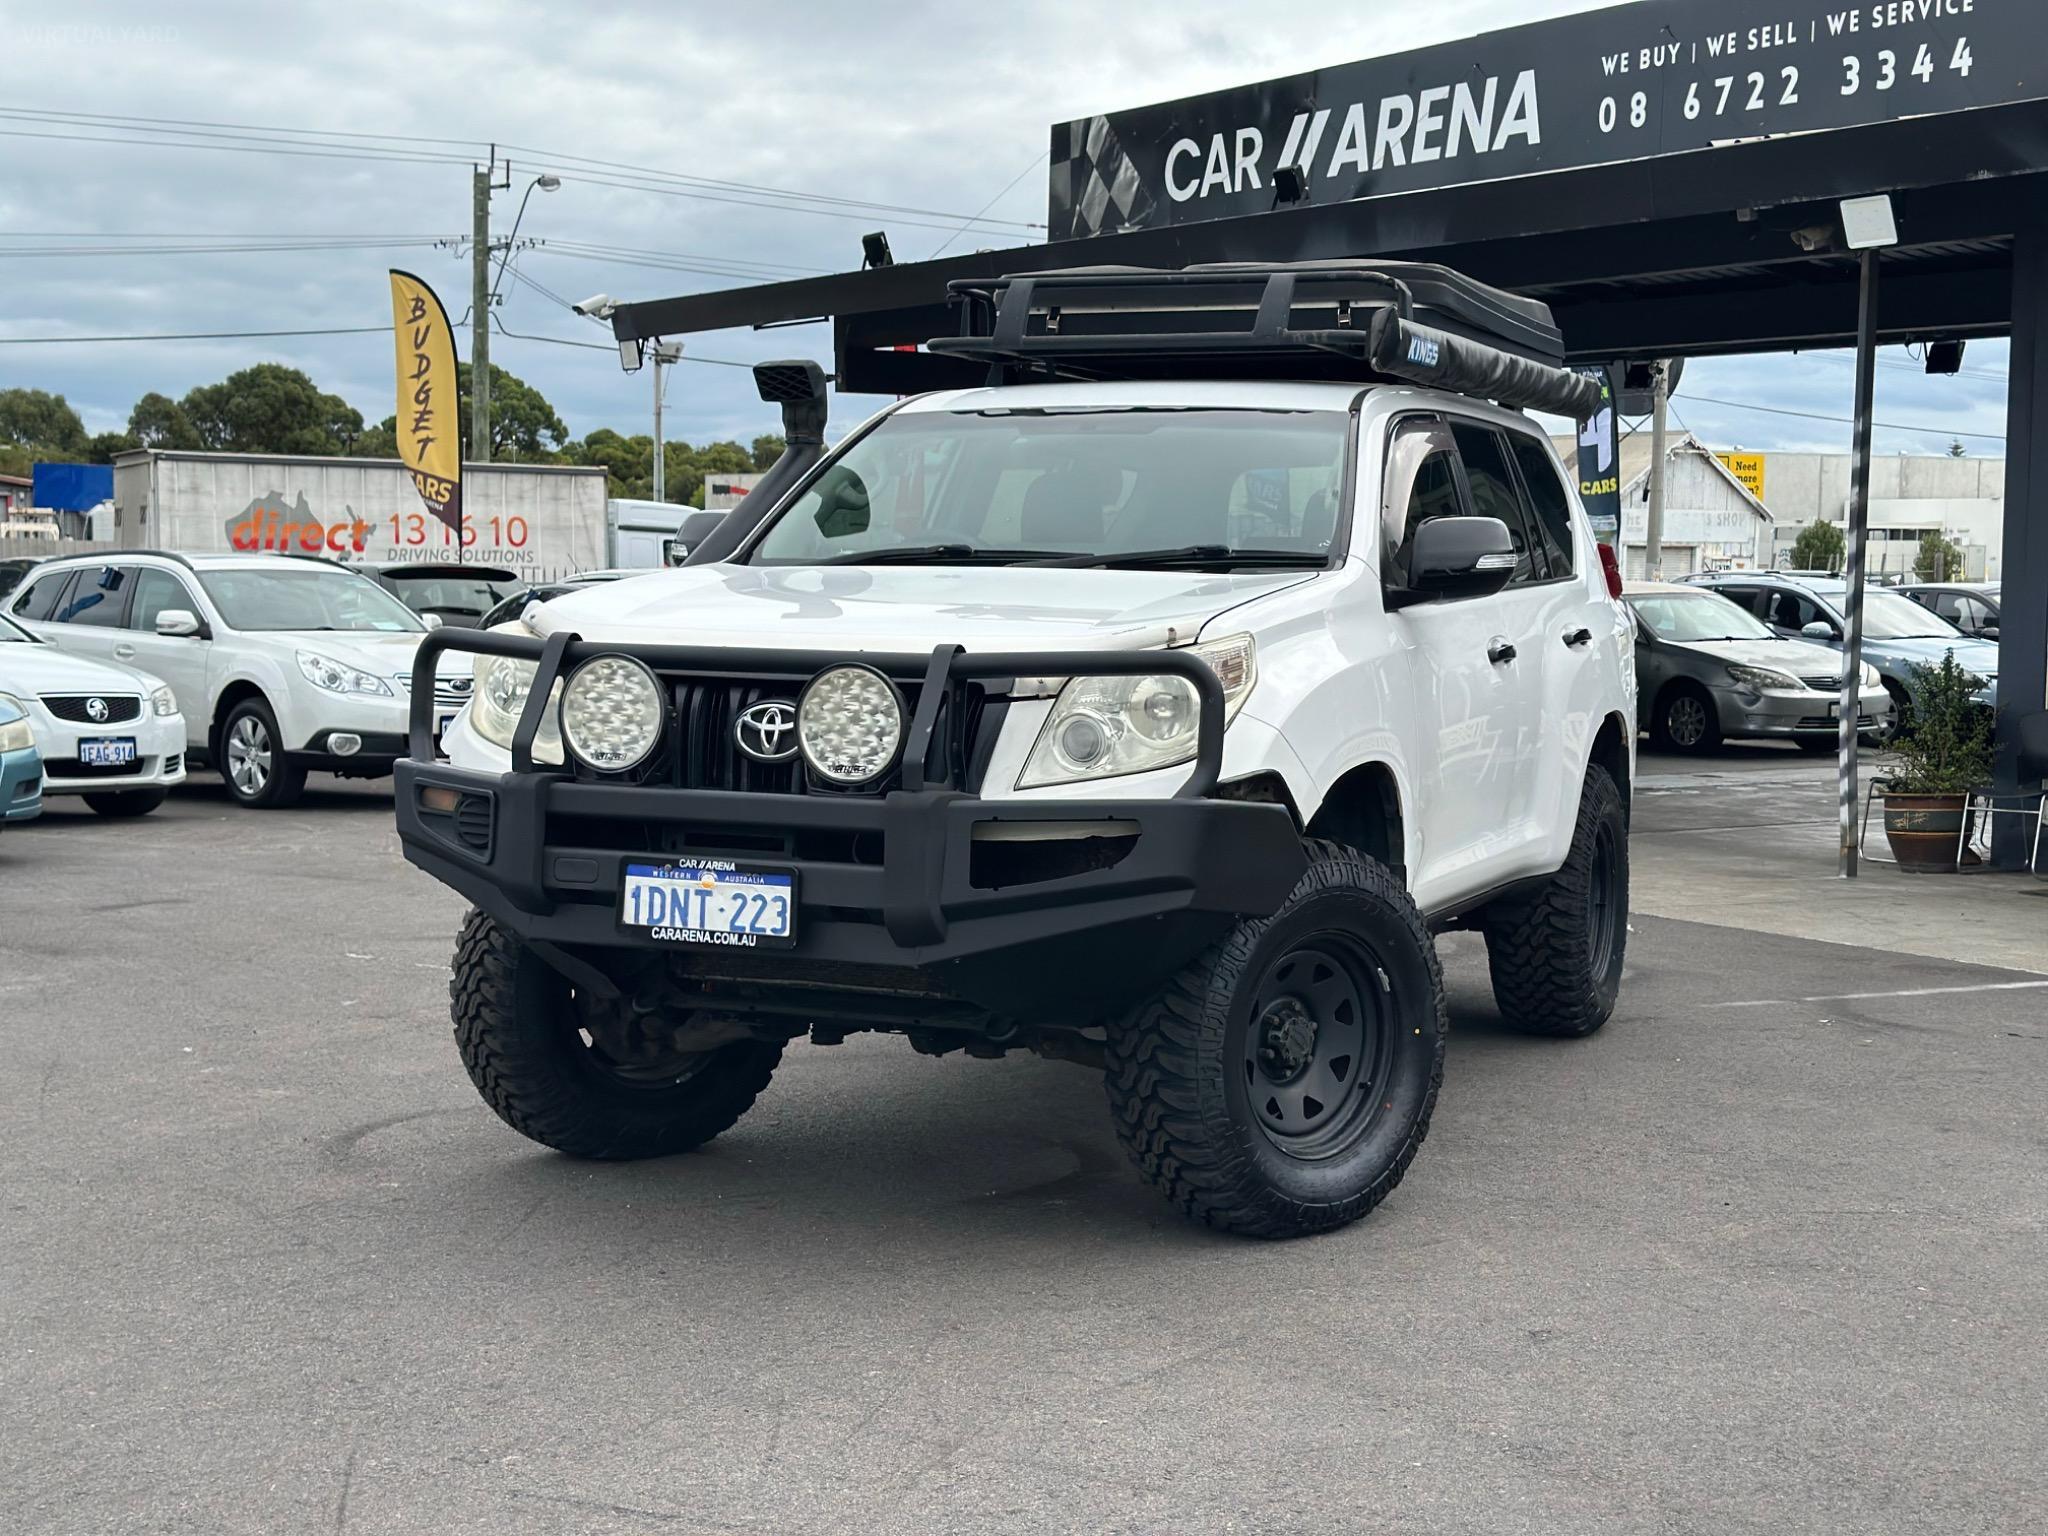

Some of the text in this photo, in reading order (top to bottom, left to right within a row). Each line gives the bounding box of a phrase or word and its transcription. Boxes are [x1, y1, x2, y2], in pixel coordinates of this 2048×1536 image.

[1602, 52, 1629, 76] WE
[1639, 42, 1680, 71] BUY
[1706, 33, 1736, 58] WE
[1748, 22, 1797, 51] SELL
[1826, 10, 1859, 36] WE
[1598, 36, 1974, 133] 08 6722 3344
[1164, 126, 1263, 202] CAR
[1407, 335, 1439, 366] KINGS
[406, 292, 437, 465] BUDGET
[1735, 461, 1757, 471] Need
[409, 471, 453, 503] ARS
[1580, 477, 1617, 496] CARS
[232, 506, 369, 553] direct
[389, 512, 426, 545] 13
[489, 515, 528, 548] 10
[387, 548, 534, 564] DRIVING SOLUTIONS
[652, 871, 765, 885] WESTERN AUSTRALIA
[679, 858, 698, 868] CAR
[651, 927, 757, 947] CARARENA.COM.AU
